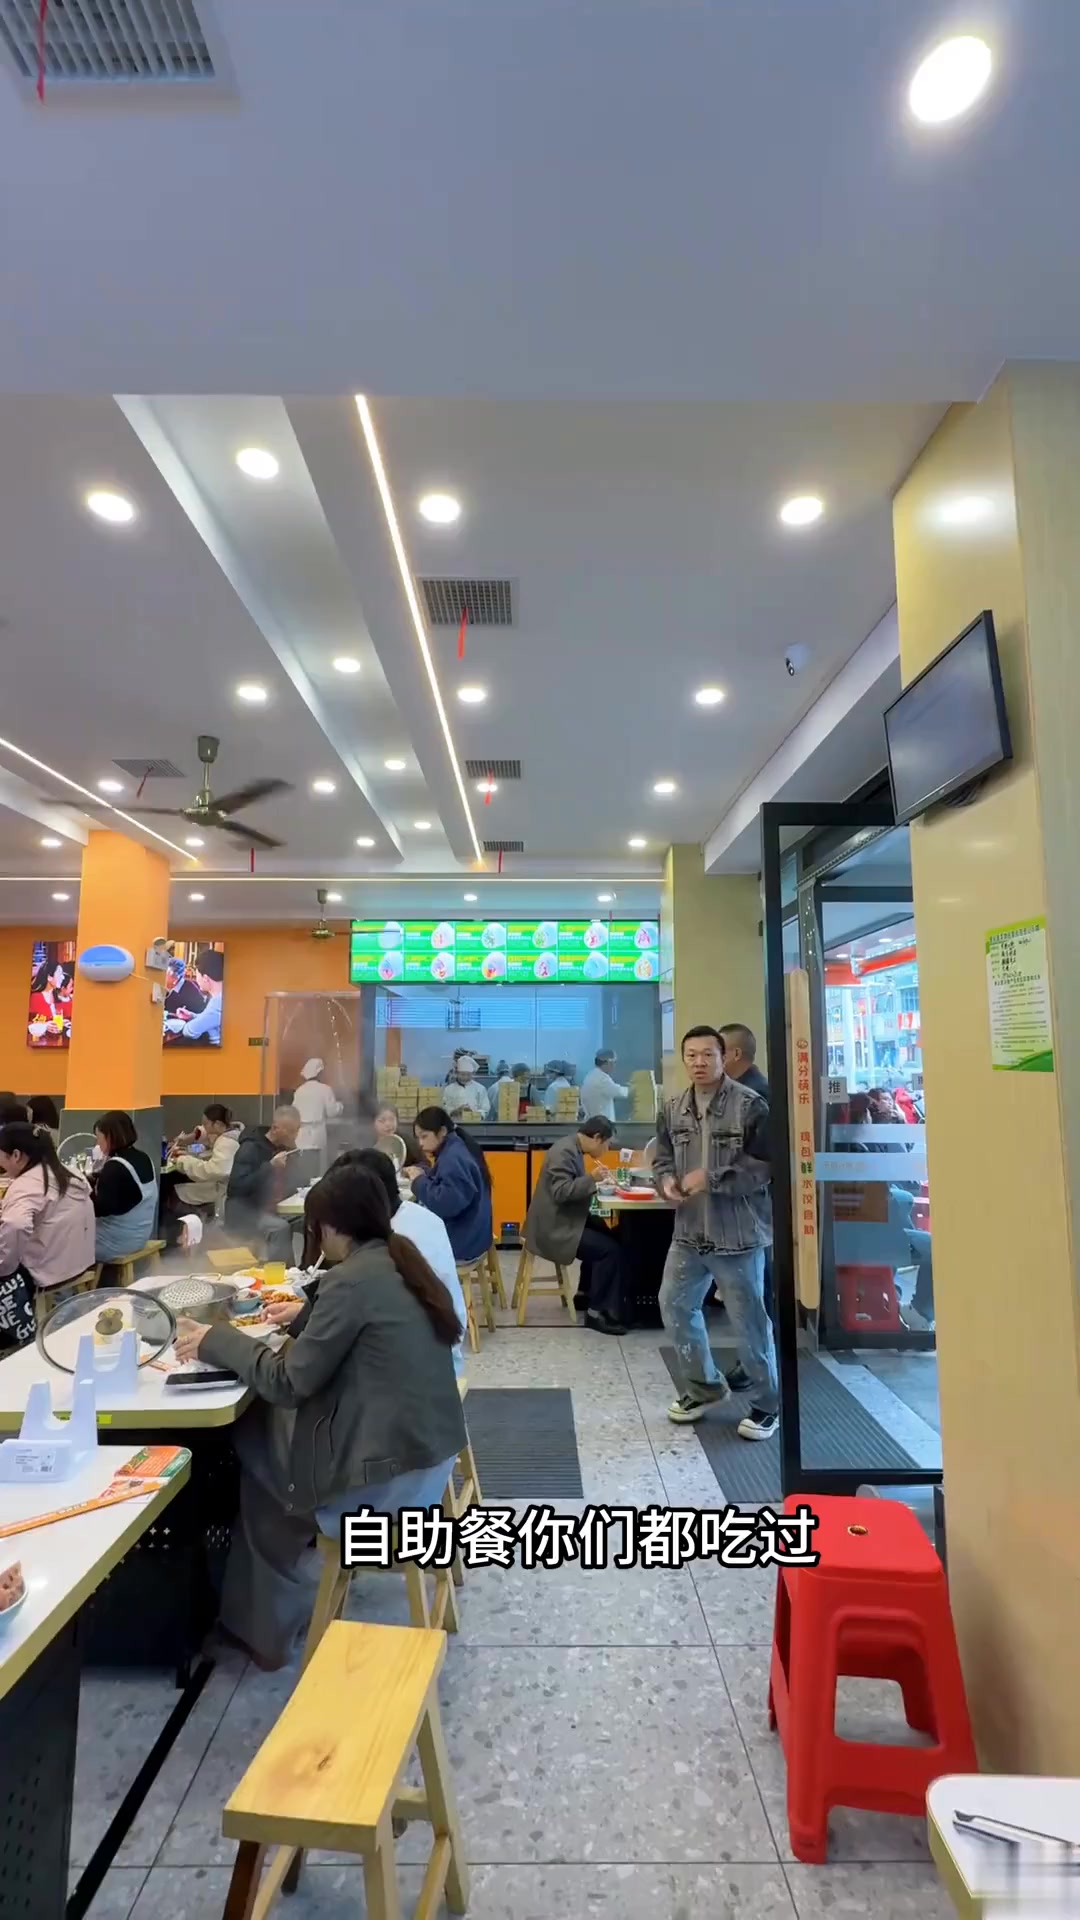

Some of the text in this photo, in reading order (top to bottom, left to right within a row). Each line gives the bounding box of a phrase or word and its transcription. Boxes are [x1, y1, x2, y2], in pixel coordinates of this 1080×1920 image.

[828, 1080, 841, 1094] 推
[800, 1131, 815, 1236] 现包鲜水饺自助
